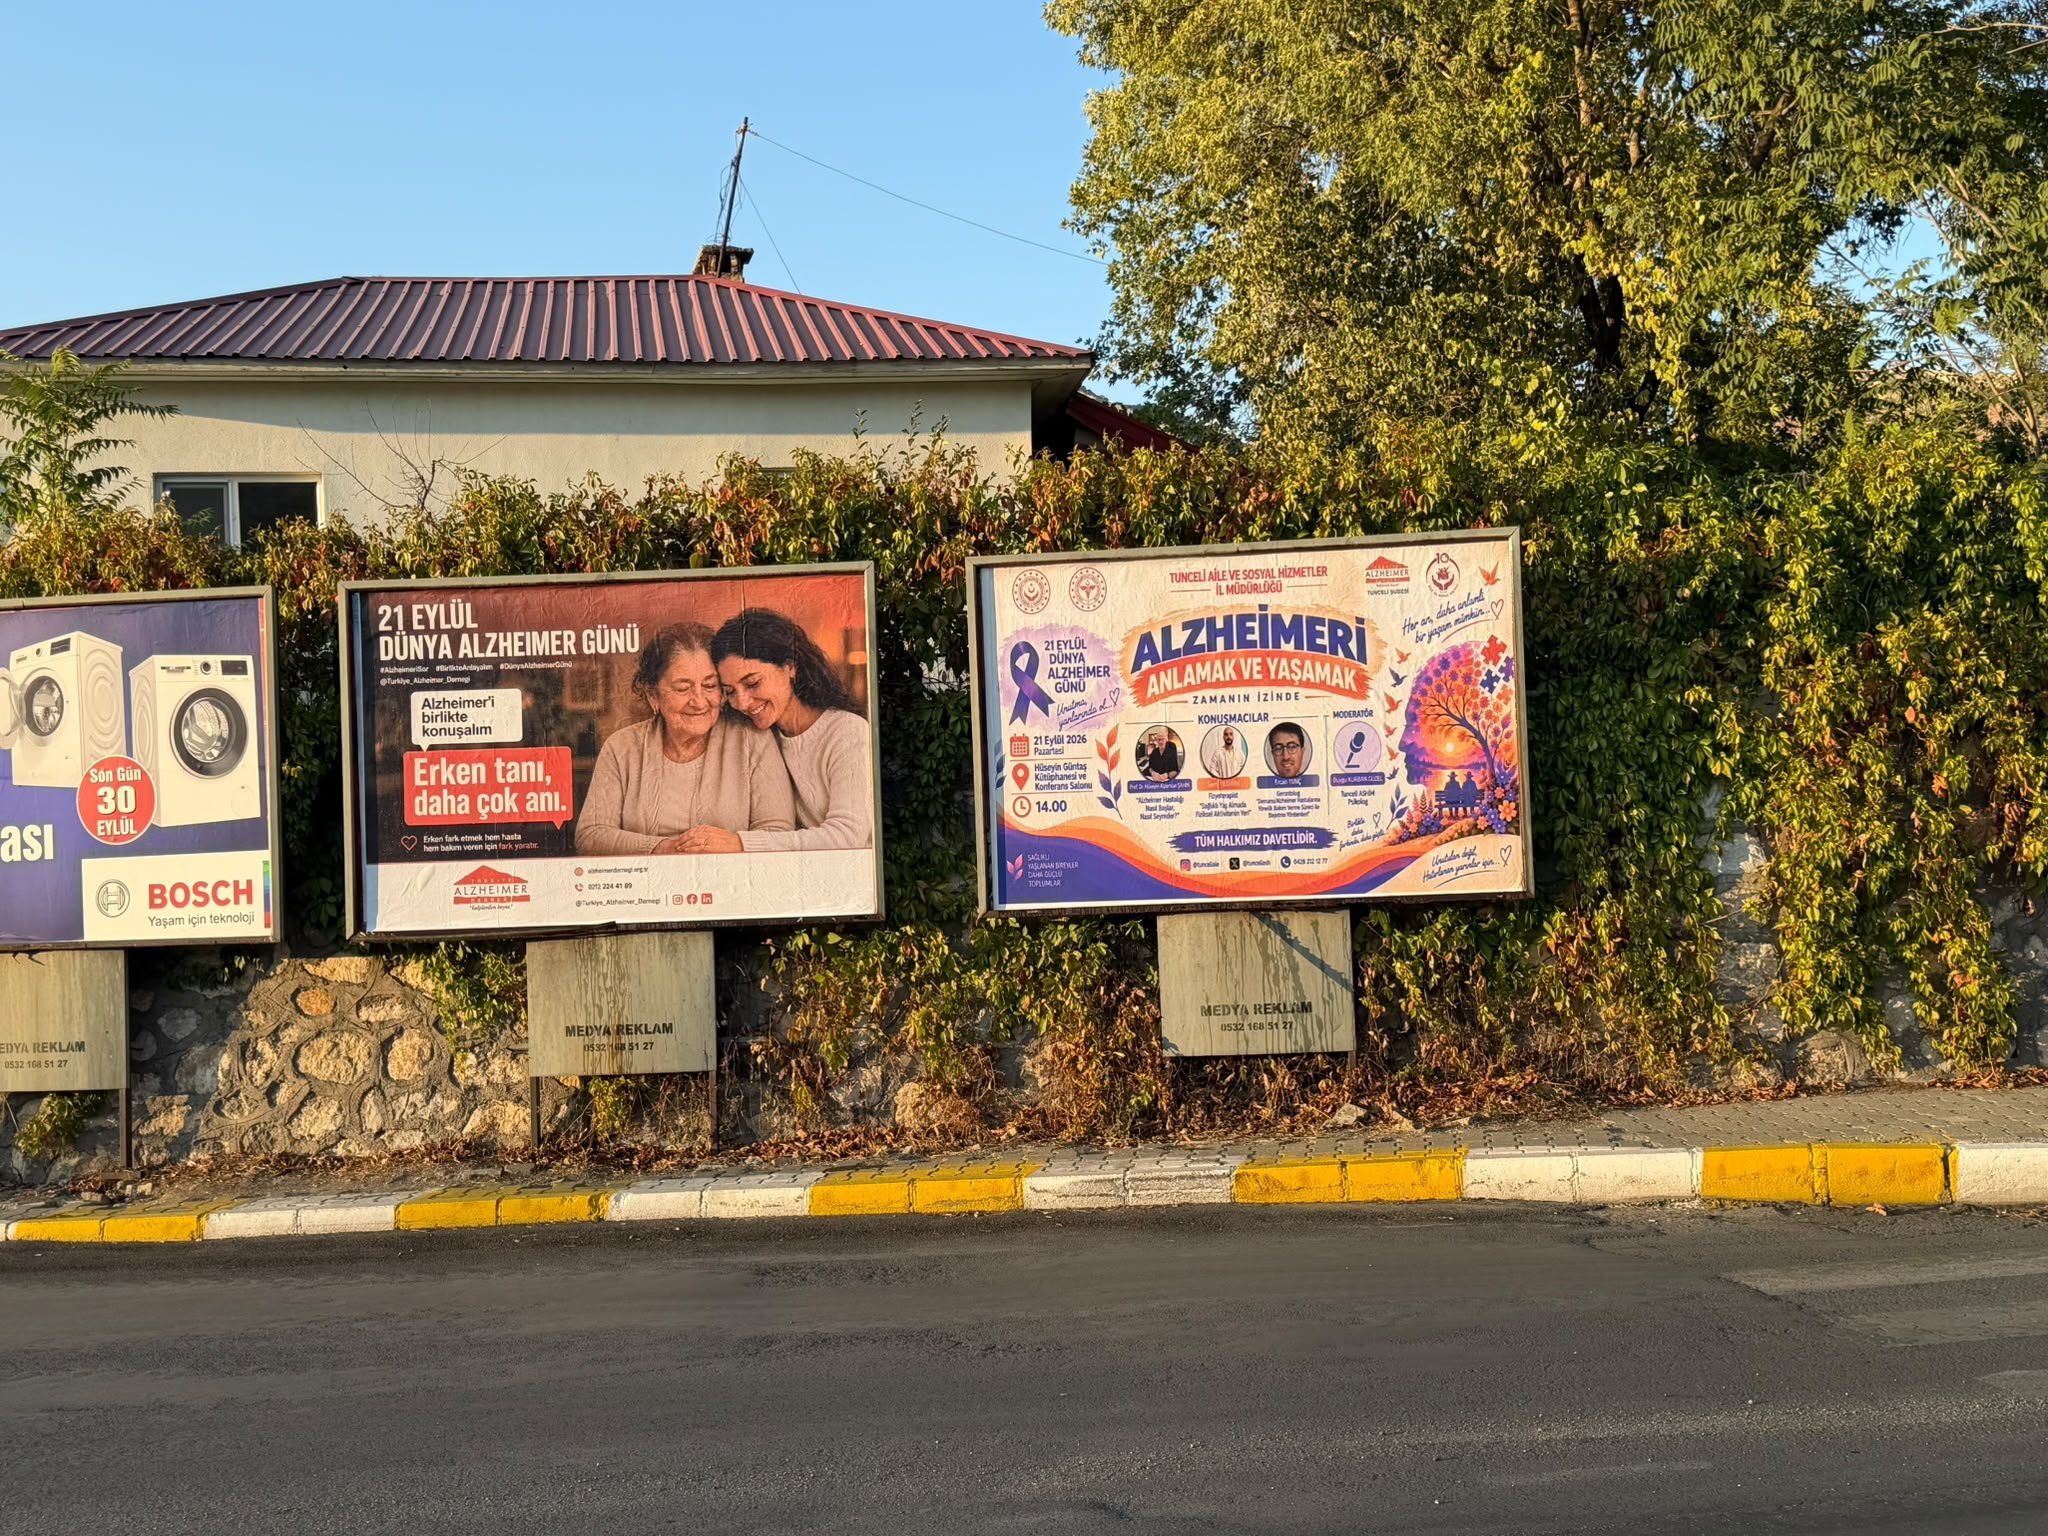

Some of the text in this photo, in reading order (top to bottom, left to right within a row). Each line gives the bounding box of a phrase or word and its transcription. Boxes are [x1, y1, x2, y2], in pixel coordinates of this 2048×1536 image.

[1170, 565, 1328, 583] TUNCELİ AİLE VE SOSYAL HİZMETLER
[1365, 569, 1409, 578] ALZHEIMER
[1216, 580, 1283, 596] İL MÜDÜRLÜĞÜ
[378, 599, 478, 631] 21 EYLÜL
[1402, 617, 1419, 636] Her
[1436, 604, 1457, 619] daha
[1130, 603, 1368, 674] ALZHEİMERİ
[1415, 629, 1427, 643] bir
[1427, 623, 1453, 644] yaşam
[379, 623, 640, 661] DÜNYA ALZHEIMER GÜNÜ
[1044, 636, 1087, 651] 21 EYLÜL
[1049, 651, 1086, 665] DÜNYA
[1146, 656, 1358, 699] ANLAMAK VE YAŞAMAK
[1055, 680, 1086, 693] GÜNÜ
[421, 695, 495, 710] Alzheimer'i
[1193, 691, 1300, 705] ZAMANIN İZİNDE
[422, 711, 468, 724] birlikte
[1198, 712, 1269, 725] KONUŞMACILAR
[1333, 709, 1374, 719] MODERATÖR
[422, 723, 492, 739] konuşalım
[1034, 734, 1087, 747] 21 Eylül 2026
[1034, 746, 1064, 756] Pazartesi
[414, 757, 552, 786] Erken tanı,
[1034, 762, 1087, 773] Hüseyin Güntaş
[90, 767, 142, 783] Son Gün
[1035, 772, 1077, 782] Kütüphanesi
[1035, 781, 1093, 791] Konferans Salonu
[97, 785, 137, 815] 30
[414, 787, 567, 820] daha çok anı.
[1036, 800, 1067, 813] 14.00
[97, 816, 137, 836] EYLÜL
[0, 824, 54, 863] ası
[423, 835, 443, 843] Erken
[1194, 830, 1317, 848] TÜM HALKIMIZ DAVETLİDİR.
[423, 844, 439, 852] hem
[440, 843, 462, 852] bakım
[463, 843, 483, 851] veren
[499, 842, 513, 850] fark
[1028, 871, 1043, 879] DAHA
[148, 879, 253, 909] BOSCH
[454, 885, 528, 895] ALZHEIMER
[148, 911, 255, 929] Yaşam için teknoloji
[1201, 1001, 1312, 1017] MEDYA REKLAM
[565, 1023, 673, 1037] MEDYA REKLAM
[1221, 1021, 1293, 1031] 0532 168 51 27
[32, 1041, 86, 1054] REKLAM
[584, 1043, 606, 1051] 0532
[628, 1042, 639, 1051] 51
[643, 1042, 654, 1050] 27
[4, 1059, 68, 1069] 0532 168 51 27
